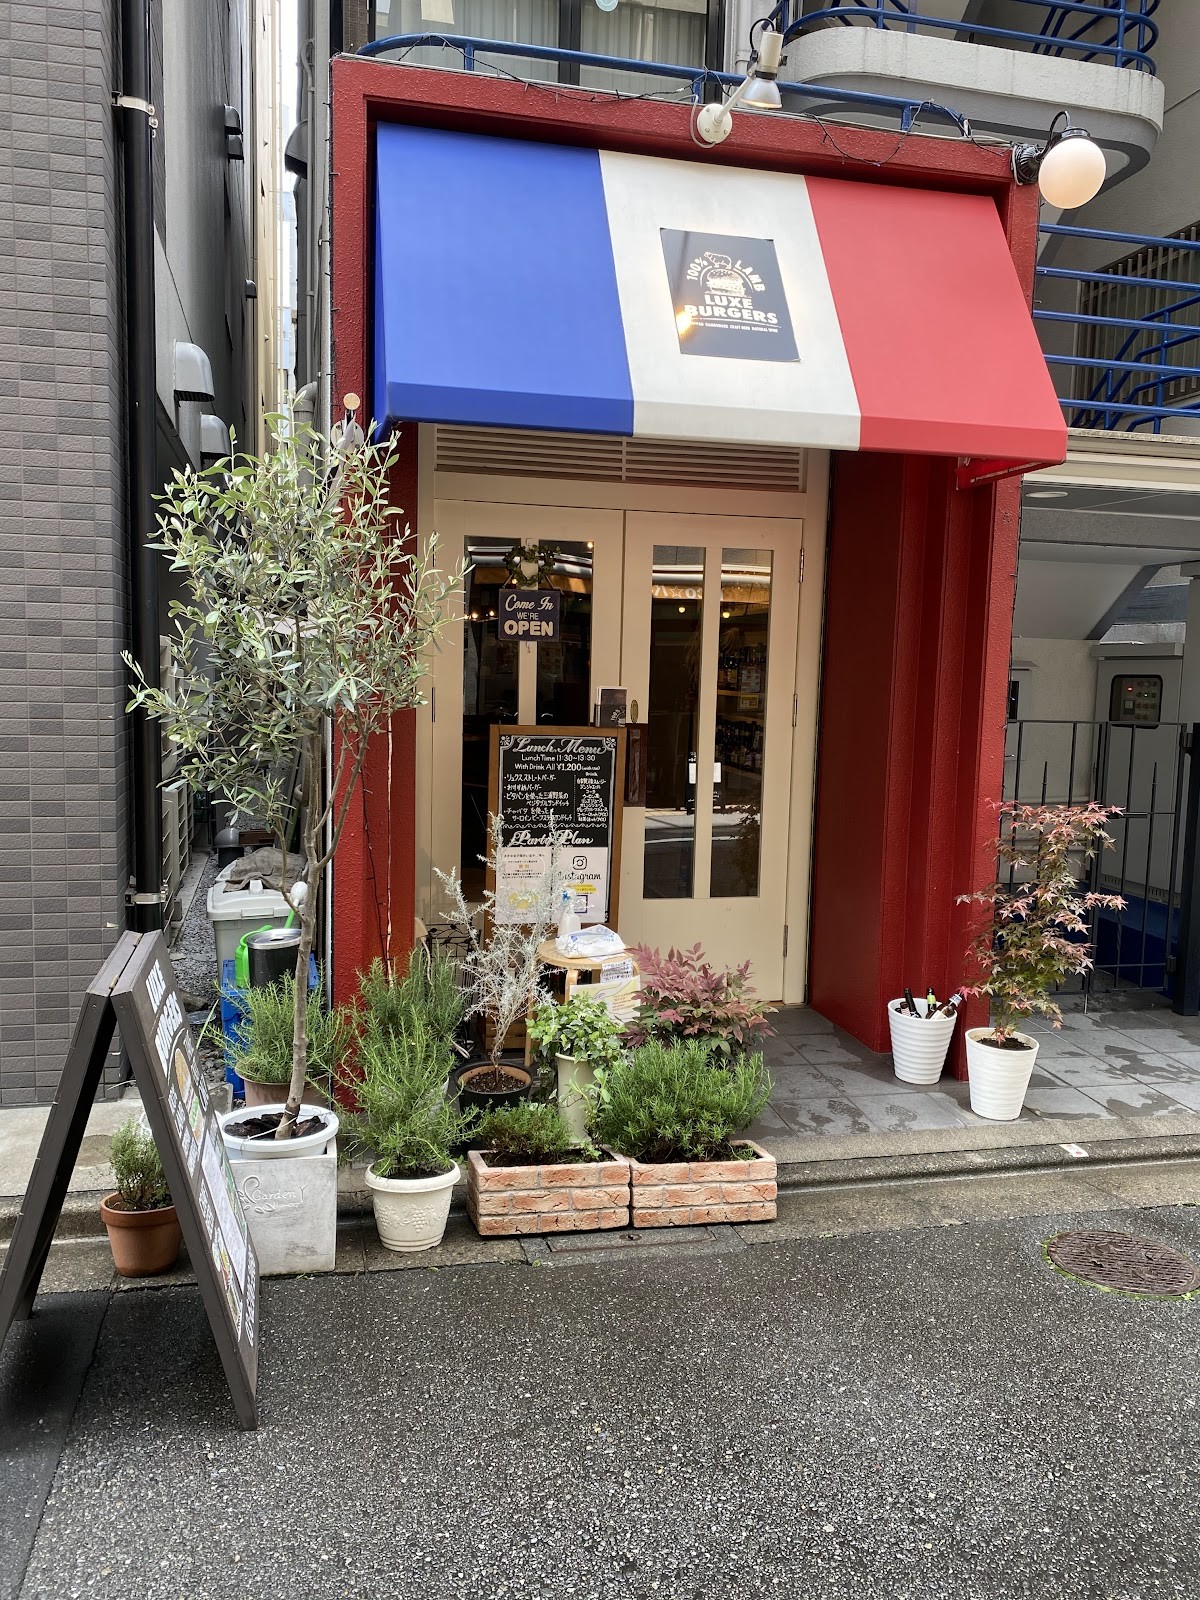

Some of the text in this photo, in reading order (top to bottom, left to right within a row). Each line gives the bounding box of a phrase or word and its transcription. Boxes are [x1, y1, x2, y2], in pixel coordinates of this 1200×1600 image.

[686, 256, 766, 292] 100% LAMB
[704, 294, 754, 309] LUXE
[684, 304, 778, 324] BURGERS
[505, 594, 554, 612] Come In
[516, 612, 539, 620] WE'RE
[504, 620, 554, 636] OPEN
[512, 738, 606, 754] Lunch Menu
[557, 763, 582, 771] ¥1,200
[508, 829, 594, 847] Party Plan
